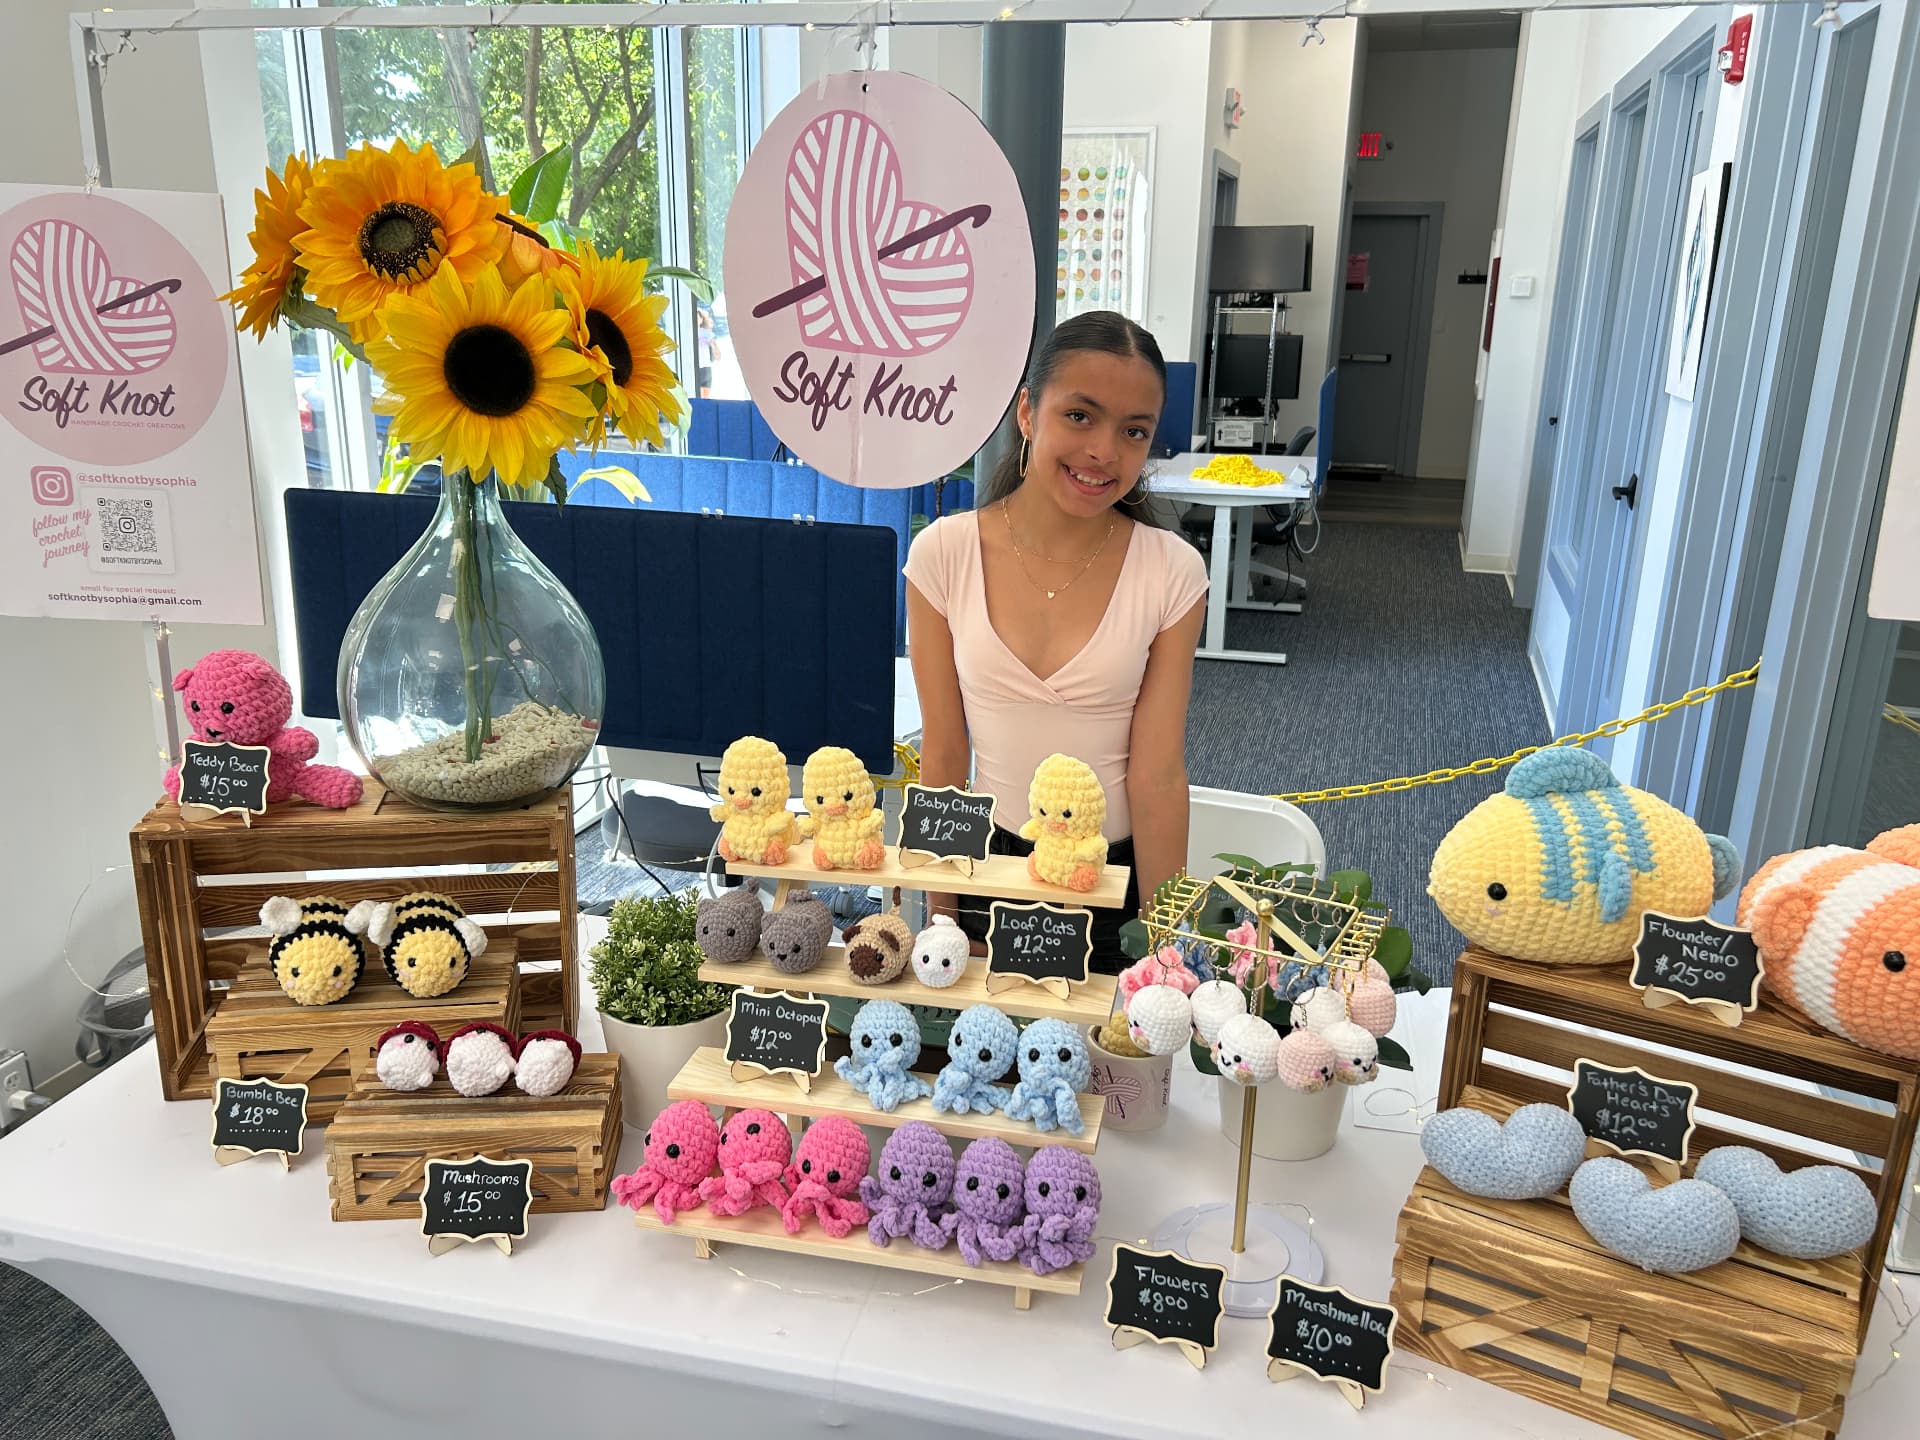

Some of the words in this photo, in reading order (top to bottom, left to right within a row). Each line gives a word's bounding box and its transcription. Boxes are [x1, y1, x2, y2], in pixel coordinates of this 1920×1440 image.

[1738, 31, 1748, 62] FIRE
[1356, 133, 1381, 157] XIT
[18, 375, 90, 429] Soft
[99, 378, 176, 417] Knot
[773, 351, 855, 432] Soft
[863, 361, 958, 426] Knot
[78, 472, 197, 488] @softknotbysophia
[32, 511, 68, 537] follow
[72, 508, 91, 525] my
[38, 525, 81, 547] crochet
[42, 540, 90, 568] journey
[48, 592, 202, 606] softknotbysophia@gmail.com
[116, 586, 143, 595] special
[190, 752, 225, 773] Teddy
[229, 756, 259, 773] Bear
[913, 792, 949, 814] Baby
[951, 798, 991, 818] Chicks
[1000, 912, 1038, 931] Loaf
[1042, 916, 1077, 936] Cats
[1682, 944, 1739, 967] Nemo
[741, 1001, 770, 1017] Mini
[775, 1005, 822, 1028] Octopus
[226, 1086, 273, 1101] Bumble
[275, 1090, 298, 1108] Bee
[1585, 1071, 1649, 1097] Father's
[1653, 1085, 1687, 1111] Day
[1606, 1090, 1670, 1118] Hearts
[442, 1169, 520, 1186] Mushrooms
[1134, 1264, 1209, 1299] Flowers
